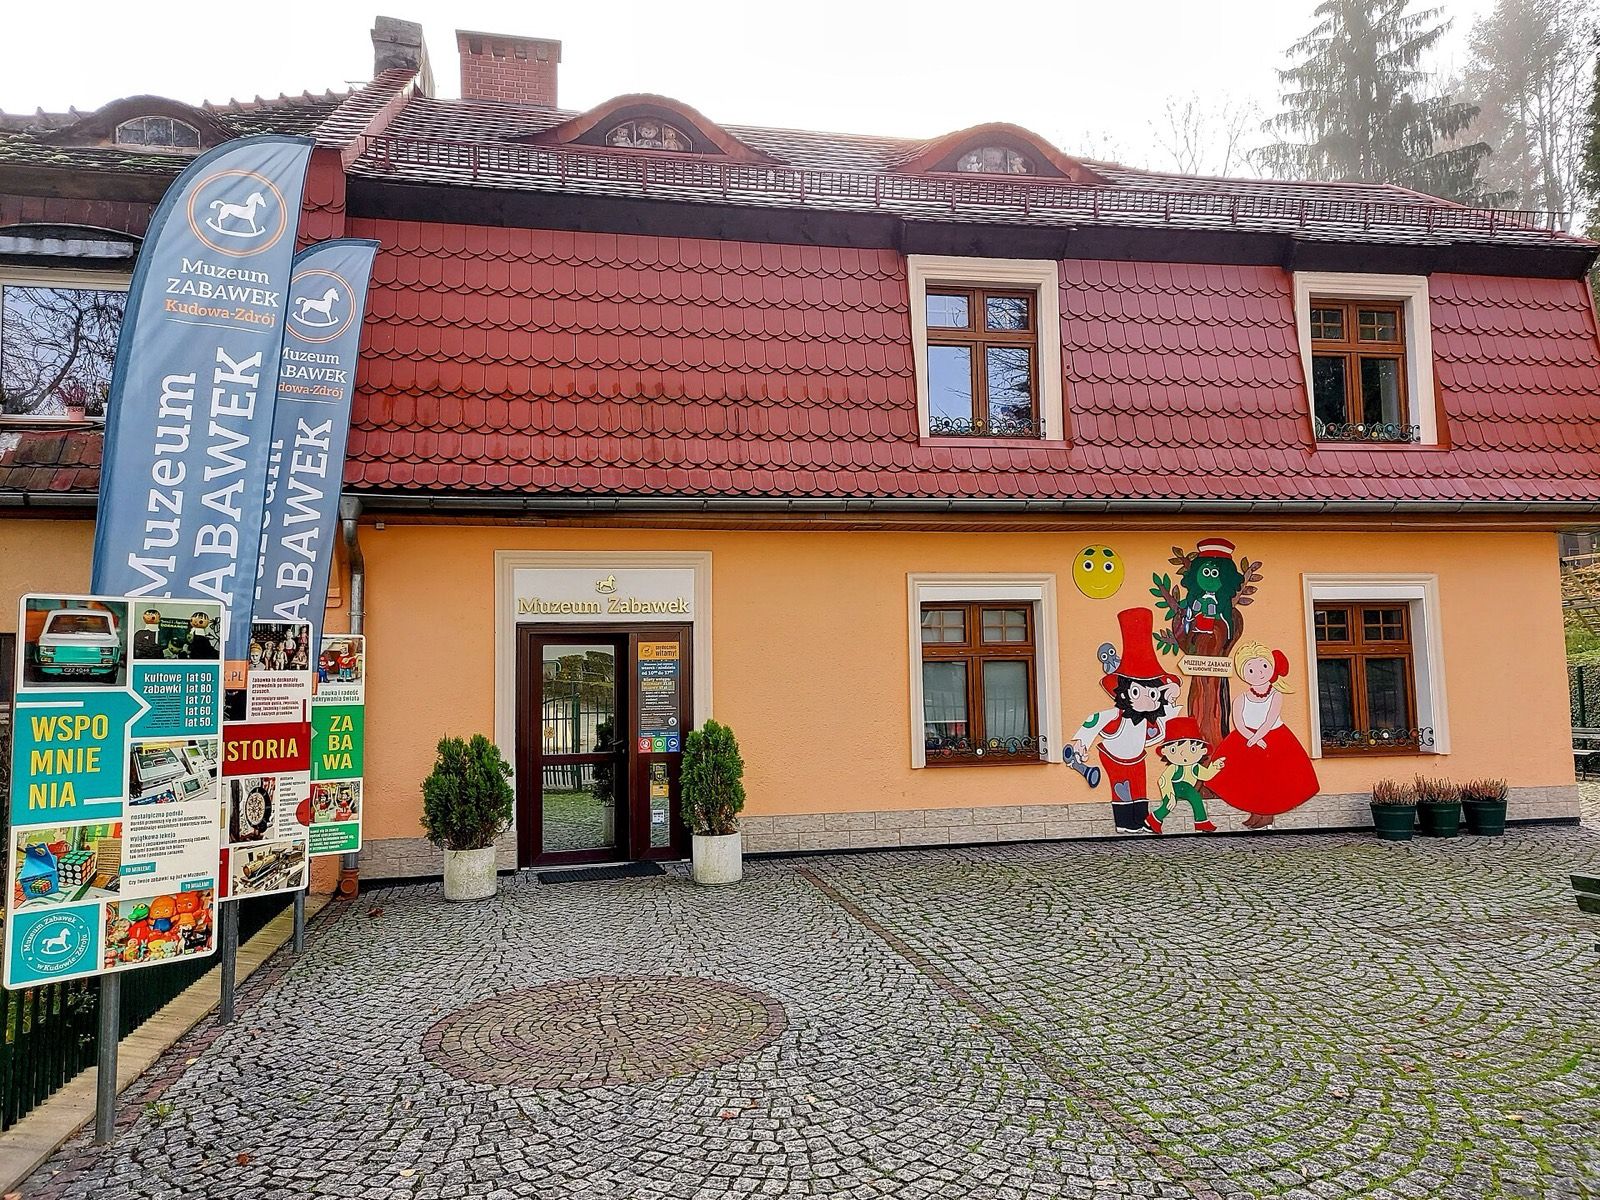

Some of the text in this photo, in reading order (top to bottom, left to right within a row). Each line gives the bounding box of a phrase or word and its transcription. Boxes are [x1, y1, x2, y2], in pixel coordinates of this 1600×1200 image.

[181, 258, 270, 285] Muzeum
[166, 278, 280, 308] ZABAWEK
[165, 299, 276, 328] Kudowa-Zdrój
[280, 365, 348, 384] BAWEK
[278, 382, 344, 399] dowa-Zdrój
[124, 372, 196, 598] Muzeum
[189, 347, 262, 641] ABAWEK
[274, 418, 332, 621] ABAWEK
[518, 596, 690, 614] Muzeum Zabawek
[145, 673, 181, 682] kultowe
[186, 673, 214, 682] lat 90.
[144, 684, 181, 694] zabawki
[186, 684, 214, 693] lat 80.
[186, 695, 214, 704] lat 70.
[185, 706, 213, 716] lat 60.
[31, 714, 108, 742] WSPO
[185, 718, 213, 727] lat 50.
[330, 716, 353, 731] ZA
[222, 738, 298, 762] ISTORIA
[329, 735, 353, 751] BA
[30, 747, 101, 776] MNIE
[323, 753, 353, 770] WA
[29, 781, 76, 810] NIA
[24, 915, 77, 952] Muzeum Zabawek
